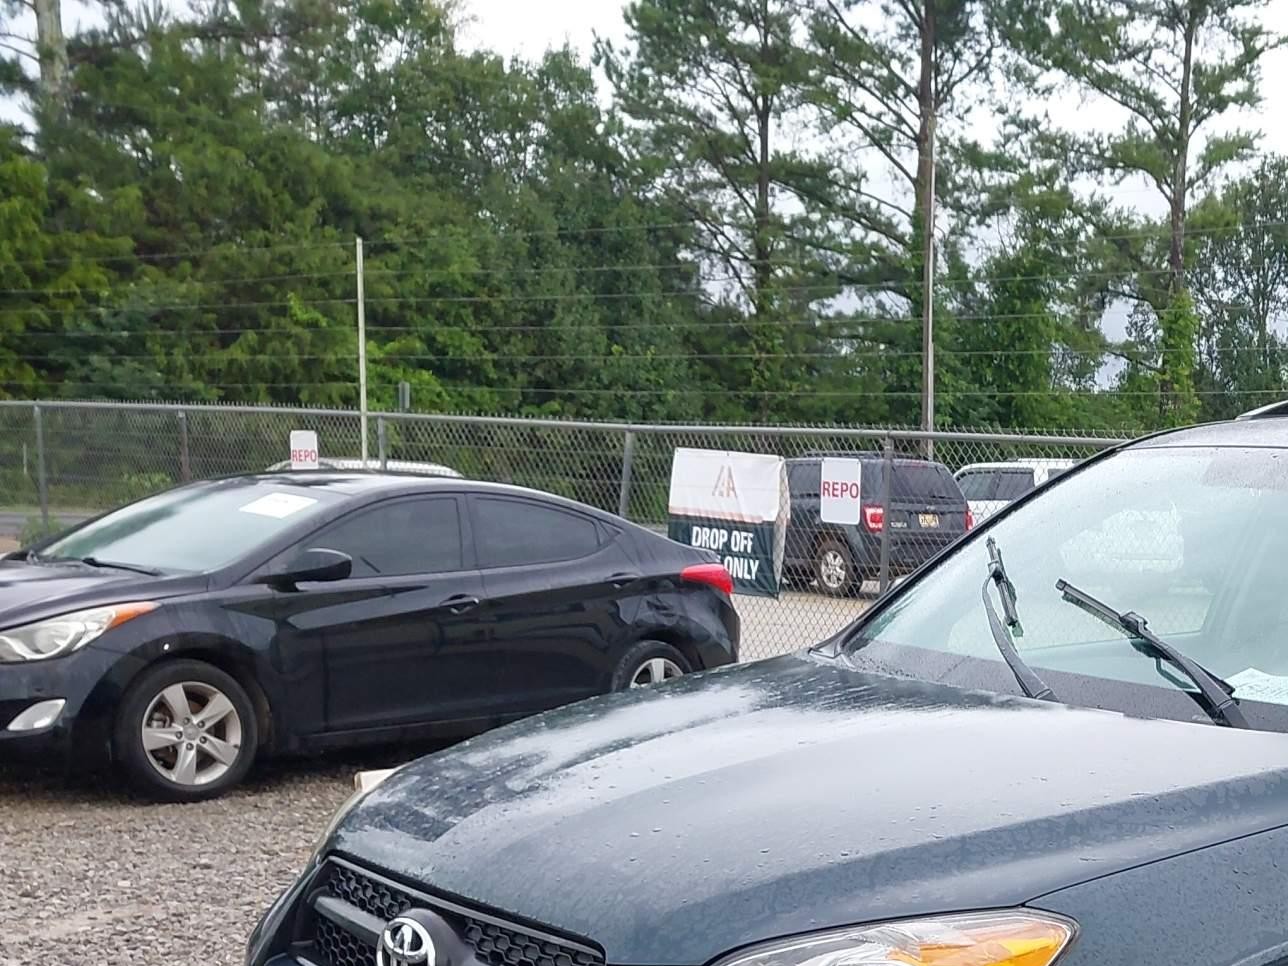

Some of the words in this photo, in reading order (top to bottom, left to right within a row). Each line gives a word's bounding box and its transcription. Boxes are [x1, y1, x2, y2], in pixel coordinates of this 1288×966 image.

[292, 449, 317, 462] REPO
[822, 480, 859, 499] REPO
[691, 526, 729, 550] DROP
[730, 530, 754, 554] OFF
[724, 555, 760, 581] ONLY
